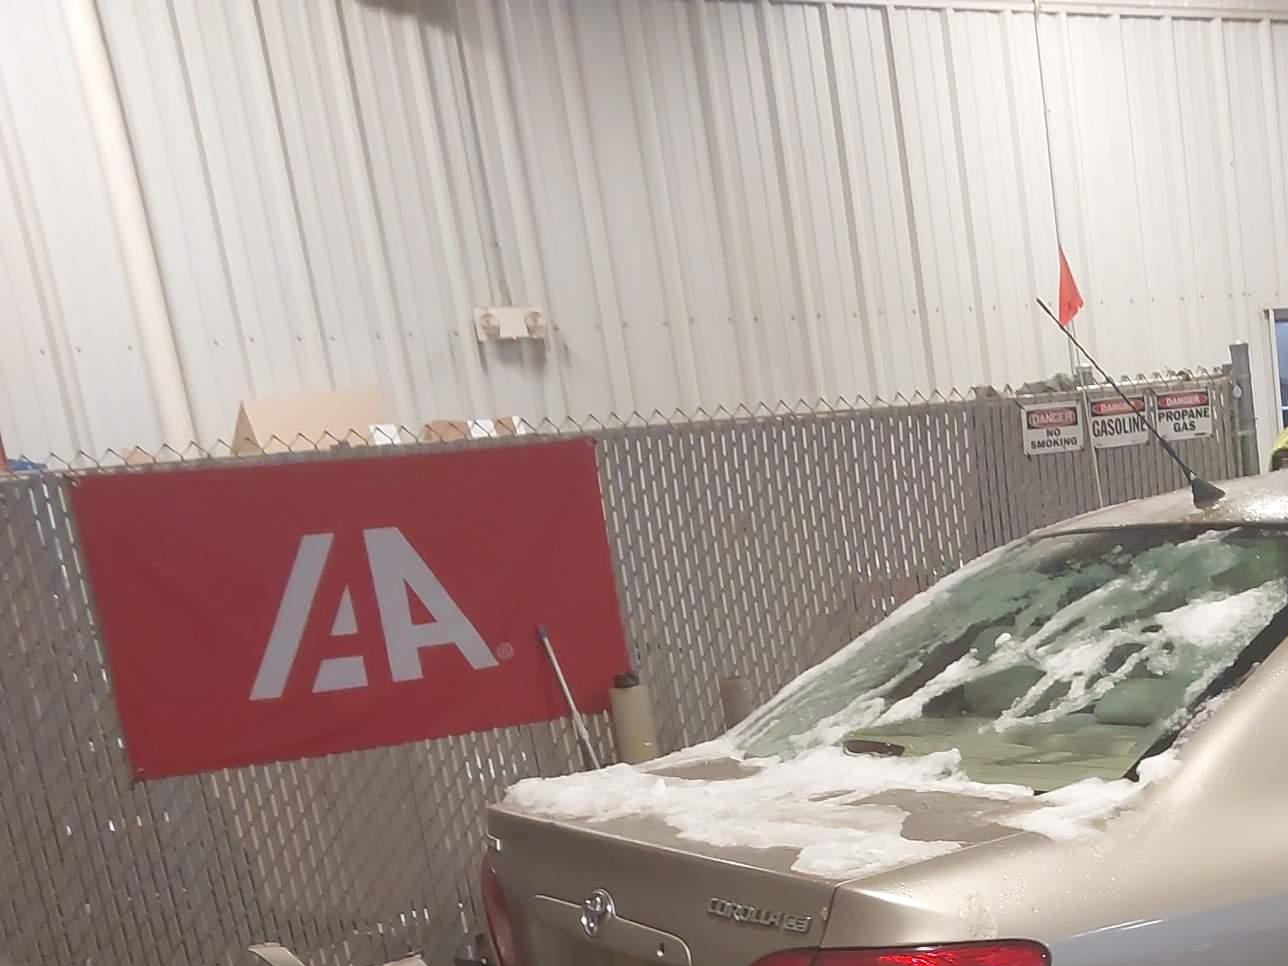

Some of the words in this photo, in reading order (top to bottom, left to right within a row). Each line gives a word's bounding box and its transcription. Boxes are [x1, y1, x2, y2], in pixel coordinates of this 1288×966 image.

[1031, 410, 1073, 426] DANGER
[1158, 407, 1210, 422] PROPANE
[1046, 428, 1061, 437] NO
[1092, 416, 1147, 437] GASOLINE
[1173, 421, 1196, 432] GAS
[1030, 437, 1077, 449] SMOKING
